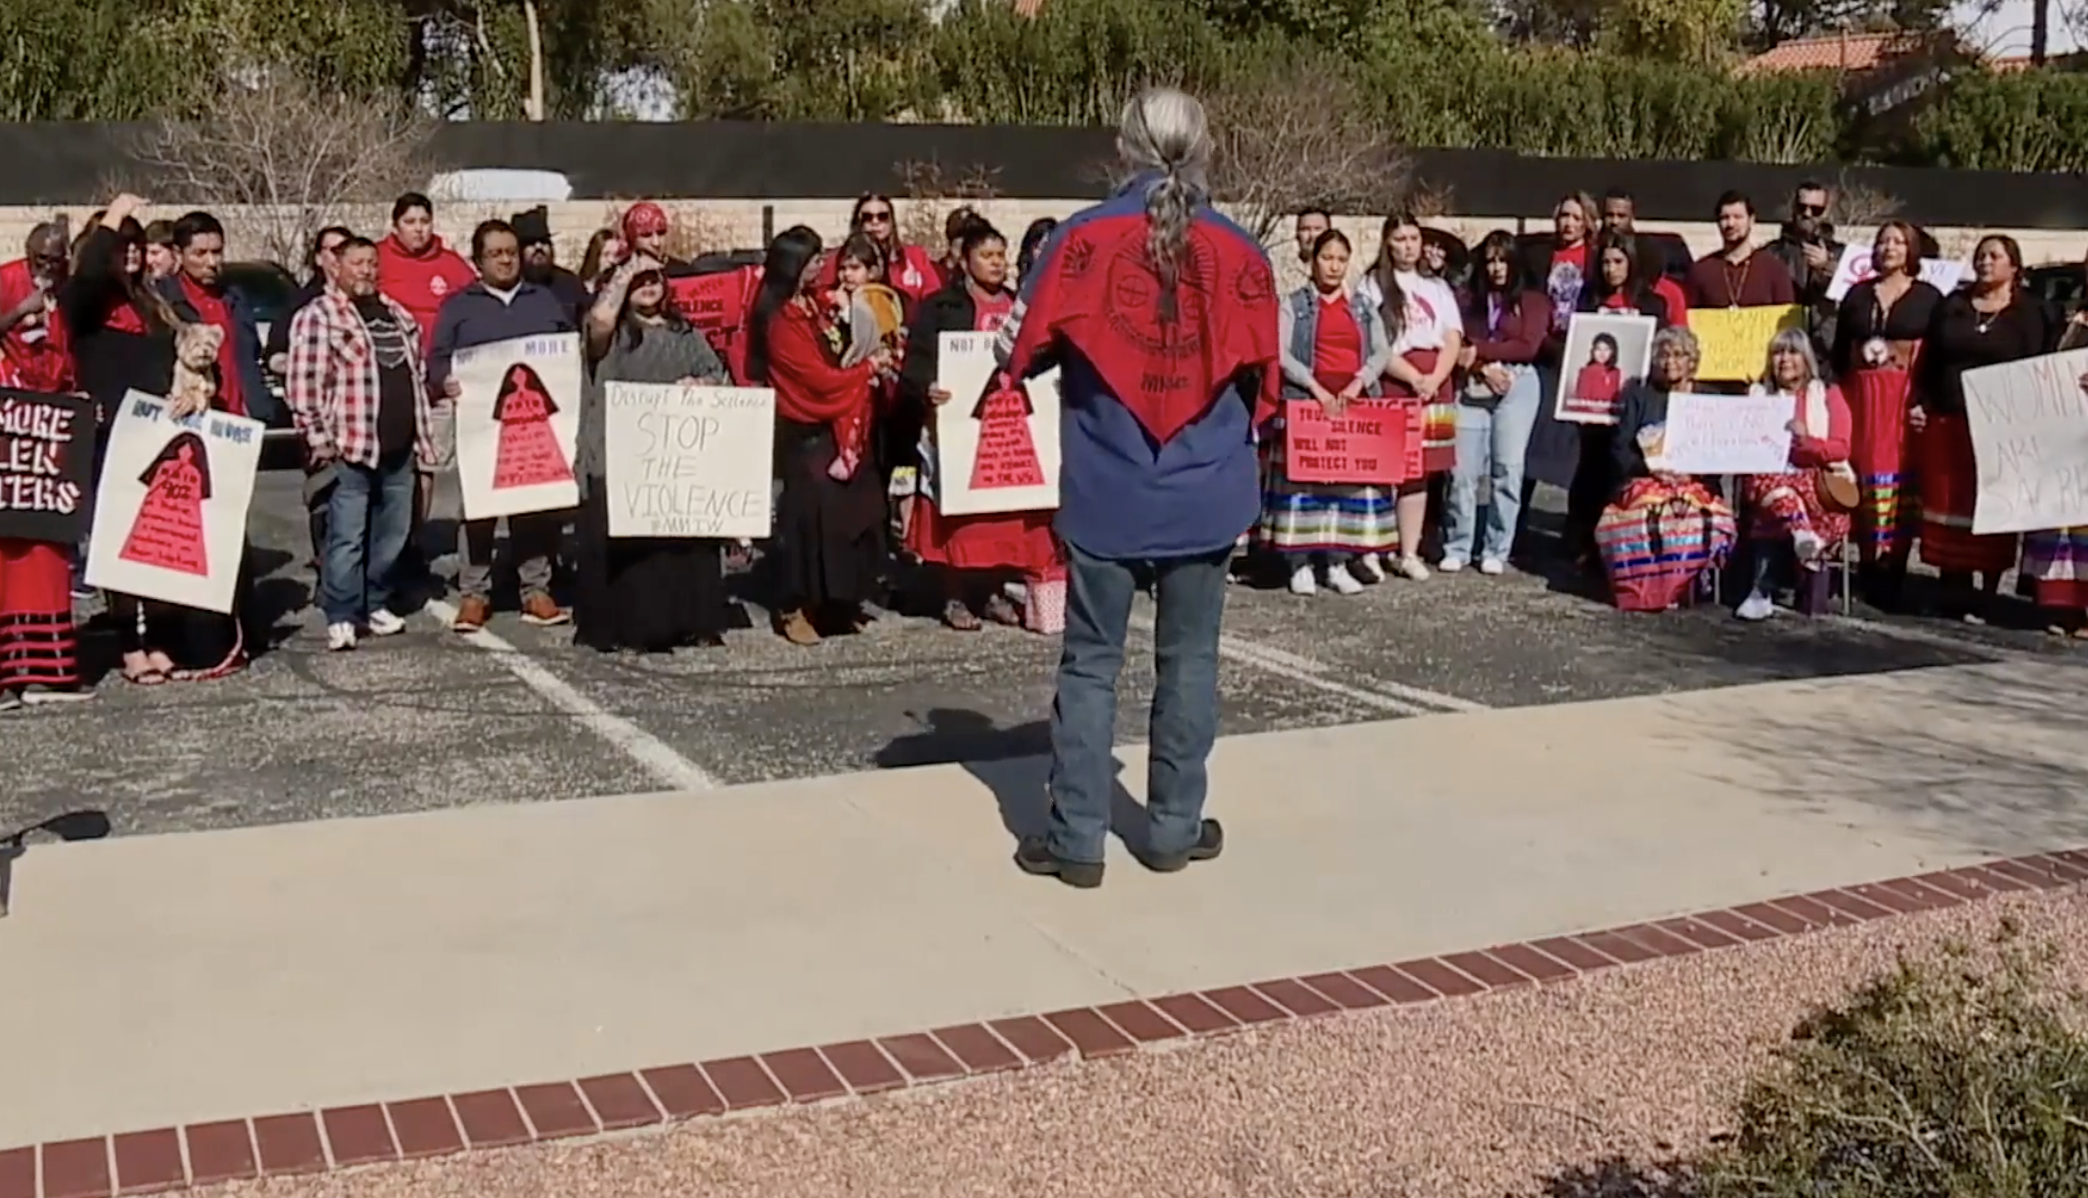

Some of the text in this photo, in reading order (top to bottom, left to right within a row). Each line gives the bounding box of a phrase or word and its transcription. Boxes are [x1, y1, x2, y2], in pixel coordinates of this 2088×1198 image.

[635, 411, 719, 456] STOP
[1331, 420, 1383, 436] SILENCE
[1293, 437, 1347, 451] WILL NOT
[642, 455, 696, 480] THE
[1299, 455, 1378, 471] PROTECT YOU
[624, 481, 762, 518] VIOLENCE
